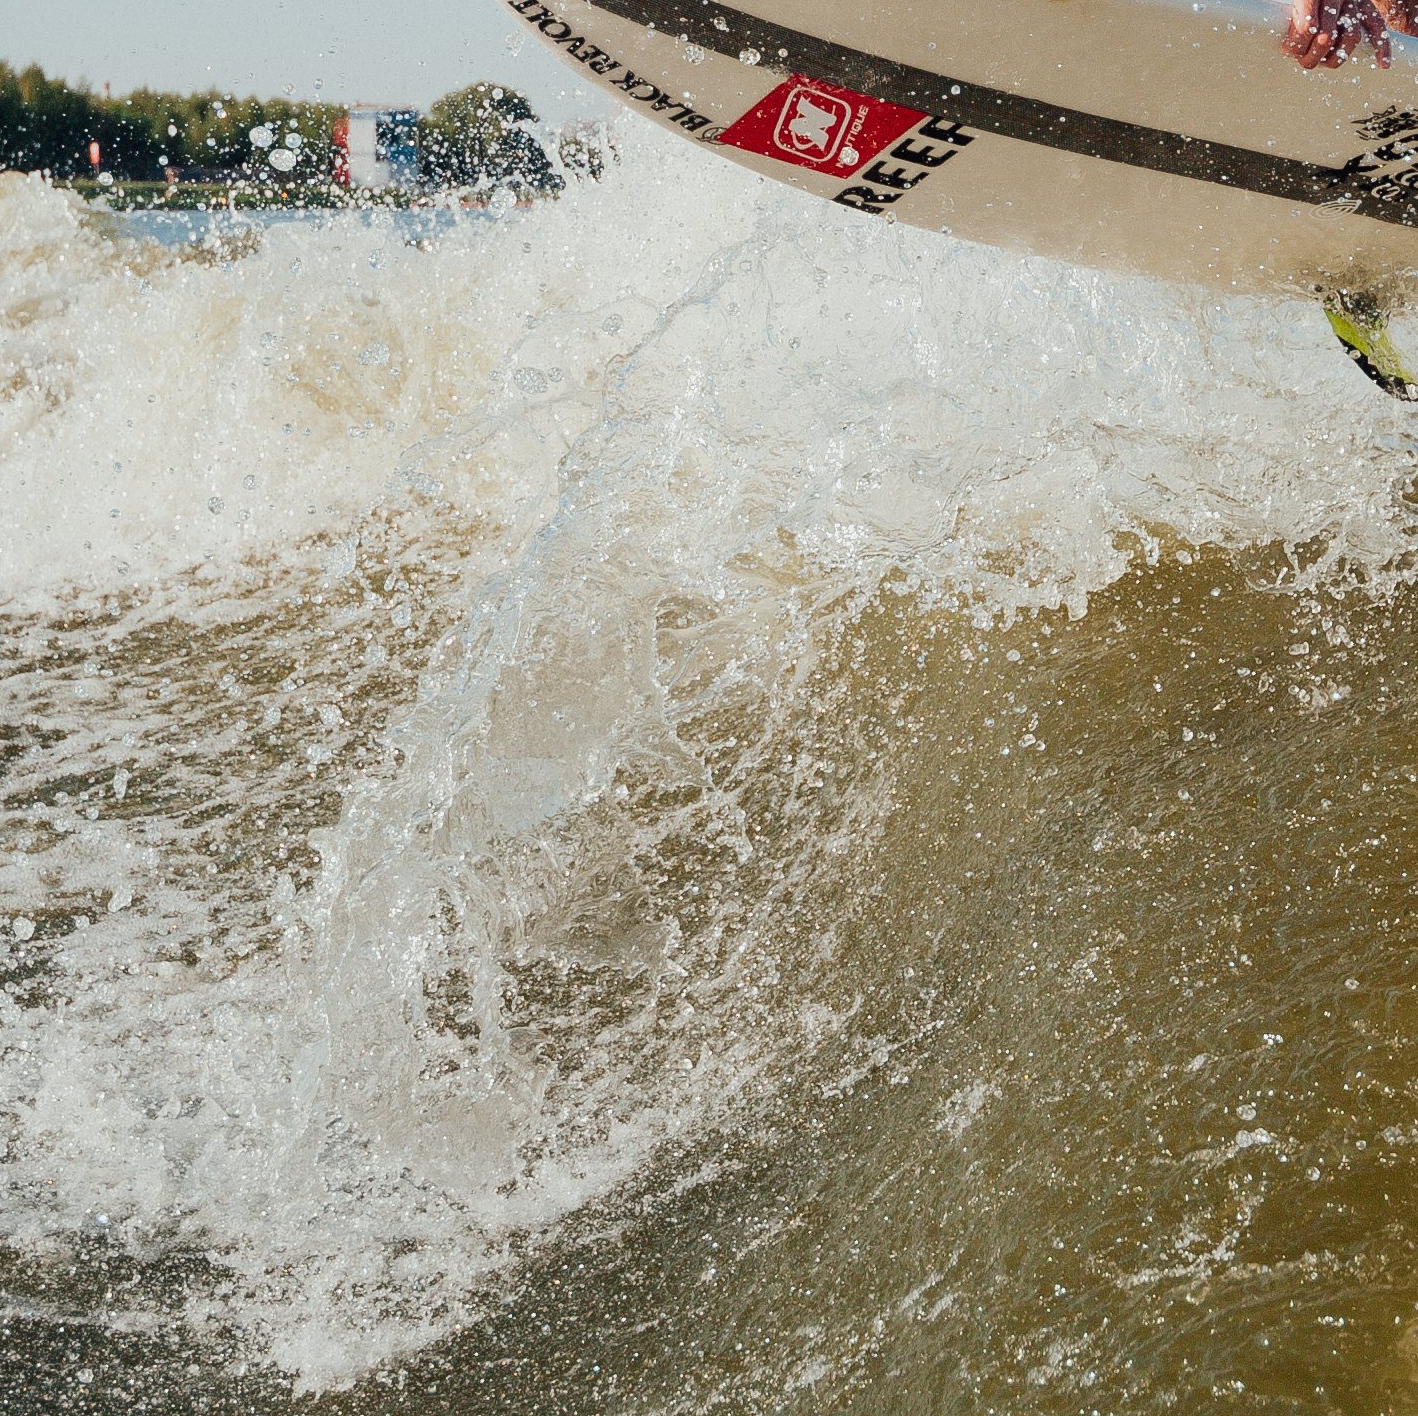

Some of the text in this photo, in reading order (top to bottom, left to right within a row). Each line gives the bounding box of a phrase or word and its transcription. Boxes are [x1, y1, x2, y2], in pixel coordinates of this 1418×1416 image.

[610, 70, 714, 133] BLACK
[833, 115, 979, 214] REEF
[835, 104, 869, 169] NUTIQUE
